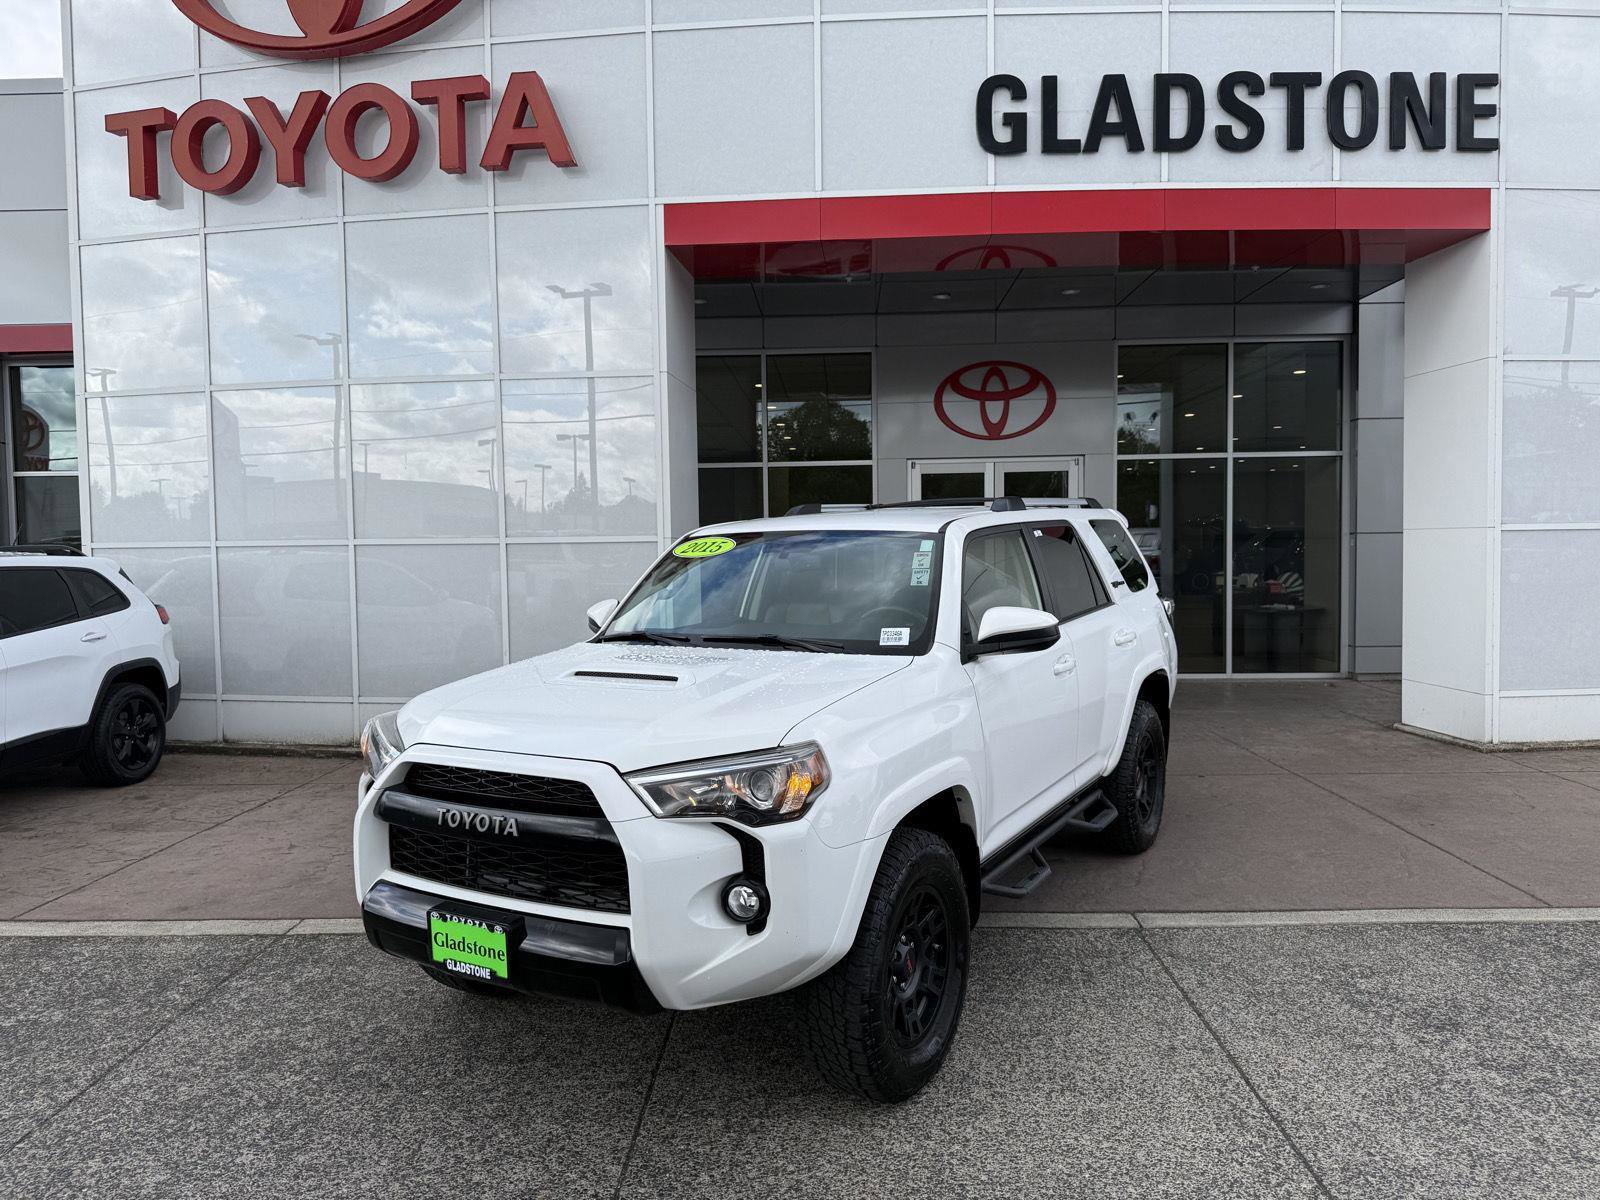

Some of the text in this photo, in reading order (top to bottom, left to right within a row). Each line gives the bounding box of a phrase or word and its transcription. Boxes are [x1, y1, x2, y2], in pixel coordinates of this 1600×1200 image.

[976, 70, 1499, 154] GLADSTONE
[105, 71, 577, 200] TOYOTA
[681, 541, 728, 553] 2015
[437, 808, 518, 837] TOYOTA
[445, 914, 488, 929] TOYOTA
[433, 931, 506, 961] Gladstone
[446, 959, 491, 979] GLADSTONE
